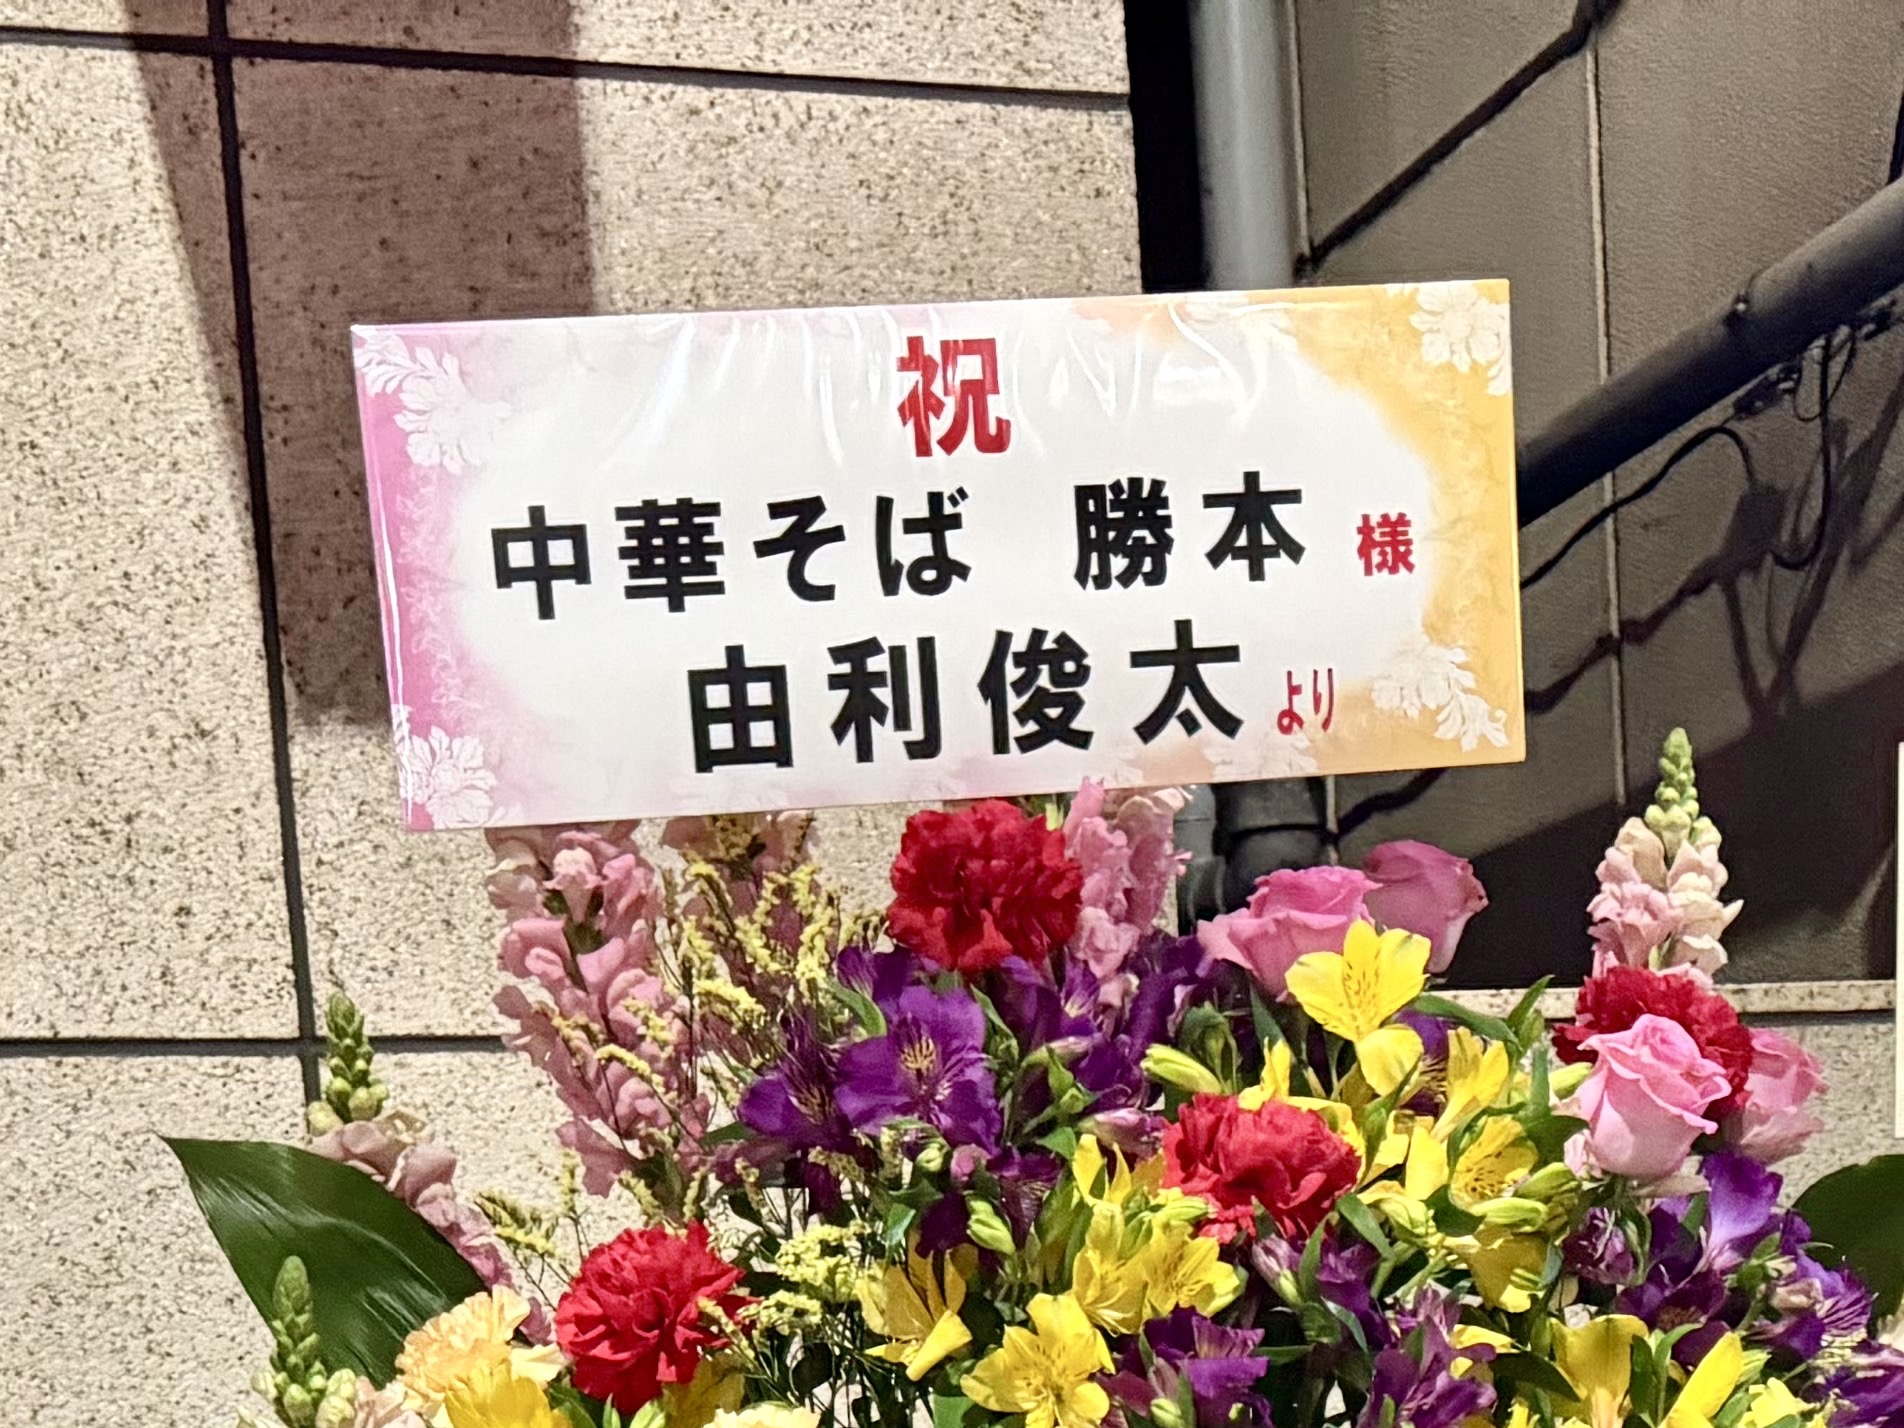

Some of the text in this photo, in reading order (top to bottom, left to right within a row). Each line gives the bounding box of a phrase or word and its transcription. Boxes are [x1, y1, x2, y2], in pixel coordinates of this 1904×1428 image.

[897, 335, 1012, 458] 祝
[490, 485, 971, 621] 中華そば
